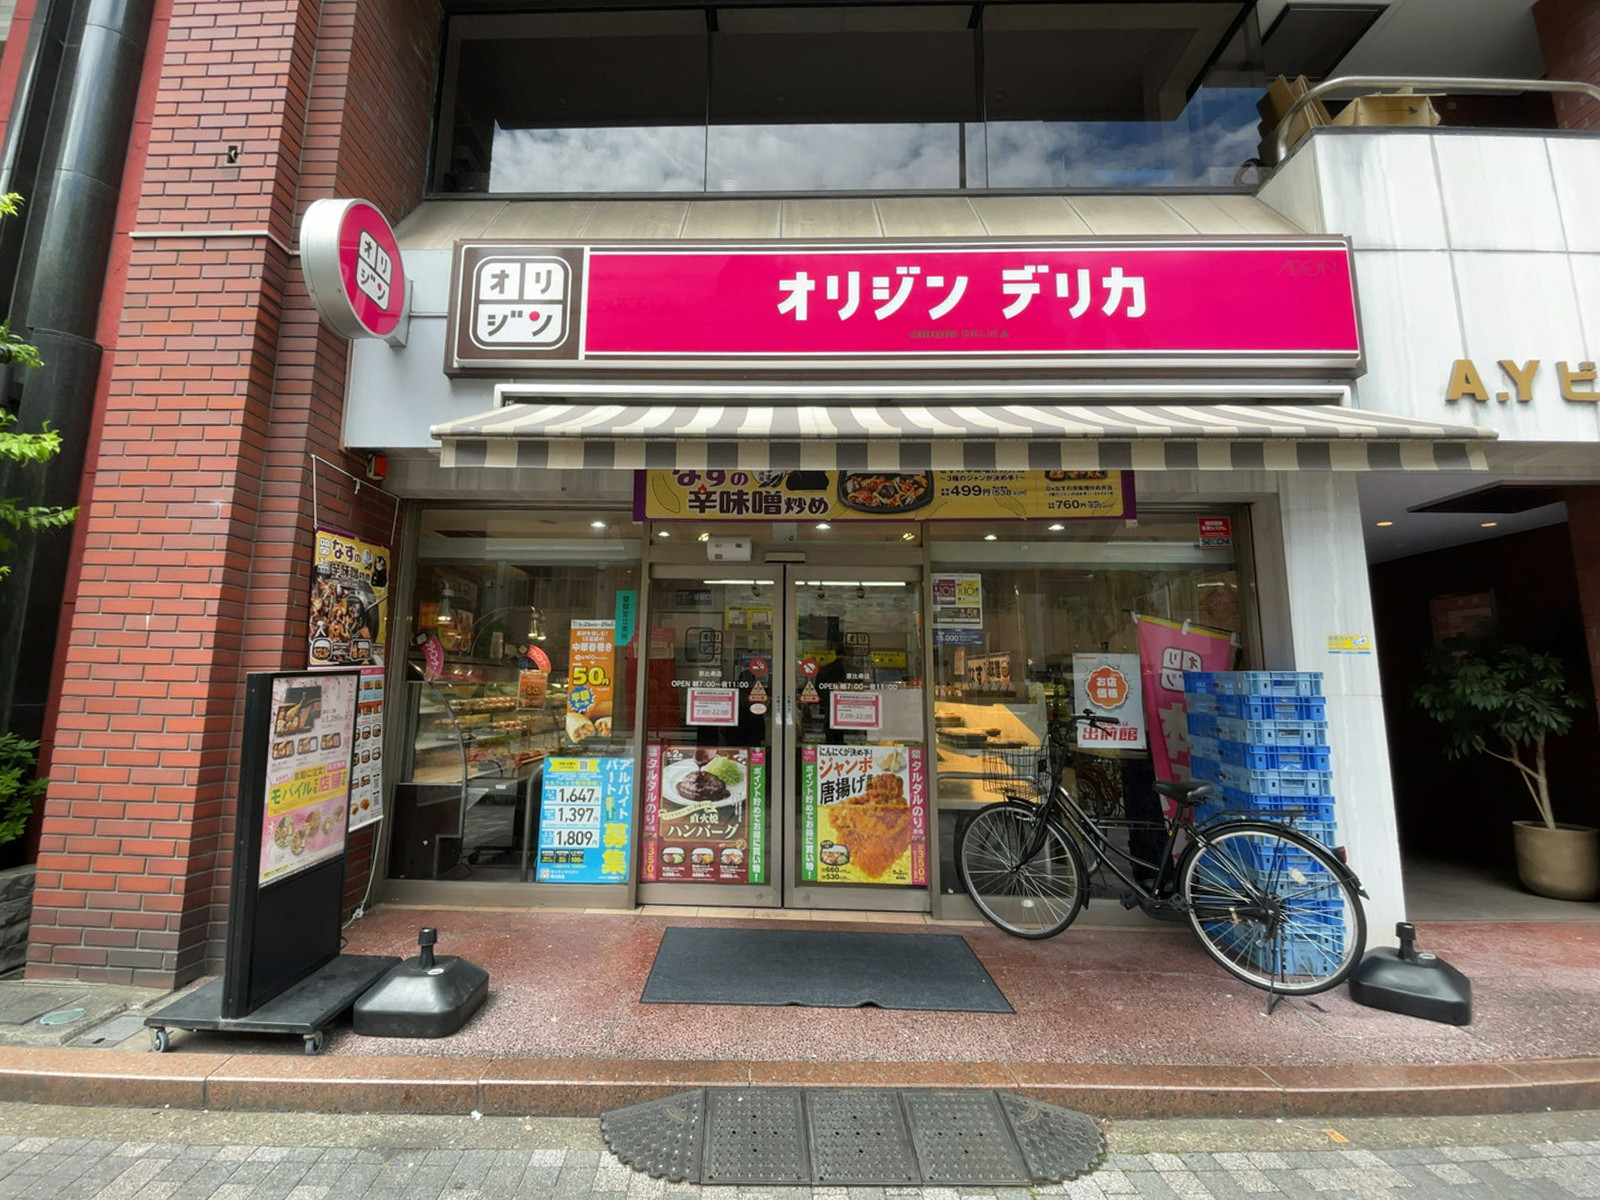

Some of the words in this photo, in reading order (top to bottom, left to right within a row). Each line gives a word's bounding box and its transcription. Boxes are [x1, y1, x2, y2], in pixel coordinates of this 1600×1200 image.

[777, 266, 968, 321] オリジン
[1002, 264, 1147, 319] デリカ
[688, 490, 830, 515] 辛味噌炒め
[331, 538, 362, 563] なすの
[671, 680, 691, 688] OPEN
[606, 759, 618, 795] パート
[819, 757, 873, 779] ジャンボ
[618, 759, 631, 820] アルバイト
[820, 774, 866, 805] 唐揚げ
[689, 813, 719, 824] 直火焼
[667, 824, 740, 840] ハンバーグ
